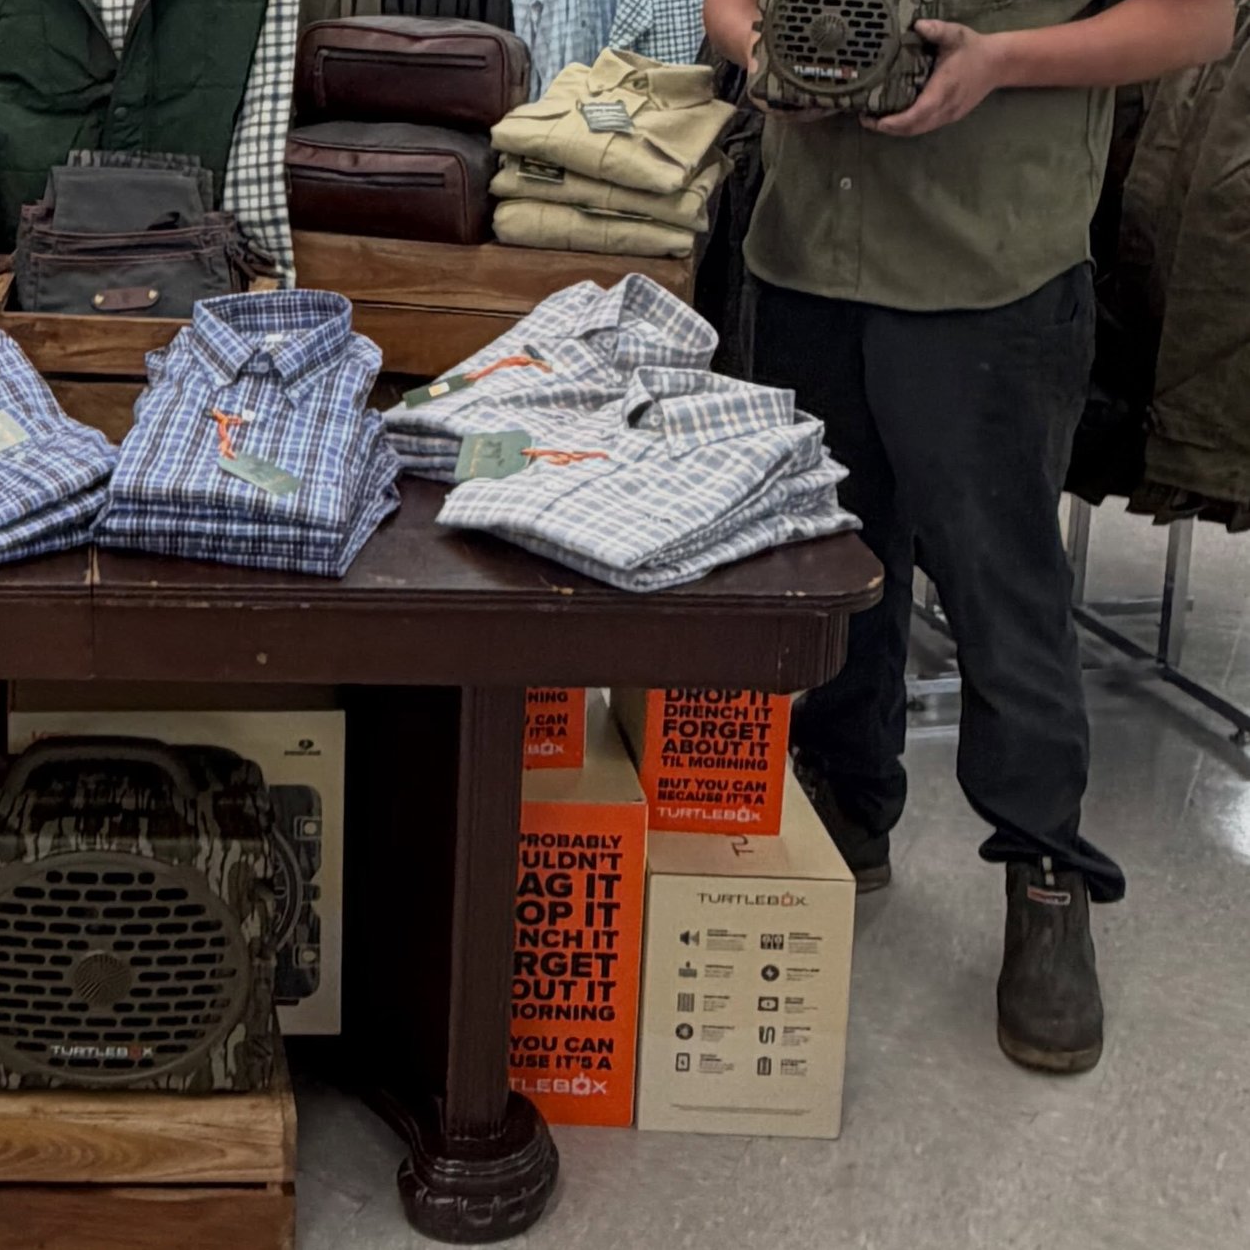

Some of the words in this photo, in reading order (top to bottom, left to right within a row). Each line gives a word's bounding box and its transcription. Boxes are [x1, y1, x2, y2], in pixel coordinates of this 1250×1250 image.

[527, 691, 569, 703] NING
[665, 689, 743, 703] DROP
[535, 713, 568, 725] CAN
[664, 704, 748, 720] DRENCH
[754, 707, 773, 721] IT
[557, 726, 567, 737] A
[663, 719, 771, 740] FORGET
[662, 738, 742, 756] ABOUT
[749, 741, 770, 757] IT
[661, 755, 684, 767] TIL
[688, 756, 768, 771] MORNING
[658, 777, 690, 789] BUT
[695, 778, 728, 790] YOU
[732, 780, 767, 792] CAN
[657, 790, 723, 802] BECAUSE
[754, 794, 765, 804] A
[656, 805, 762, 823] TURTLEBOX
[522, 851, 623, 870] ULDN'T
[517, 872, 574, 898] AG
[586, 873, 623, 899] IT
[697, 891, 808, 907] TURTLEBOX
[515, 900, 574, 926] OP
[585, 901, 621, 928] IT
[519, 929, 584, 949] NCH
[593, 930, 620, 949] IT
[513, 951, 618, 978] RGET
[512, 979, 577, 1002] OUT
[587, 980, 617, 1002] IT
[50, 1042, 153, 1061] TURTLEBOX
[510, 1035, 558, 1051] YOU
[564, 1036, 614, 1054] CAN
[556, 1054, 593, 1070] IT'S
[596, 1056, 612, 1071] A
[509, 1072, 608, 1096] TLEBOX
